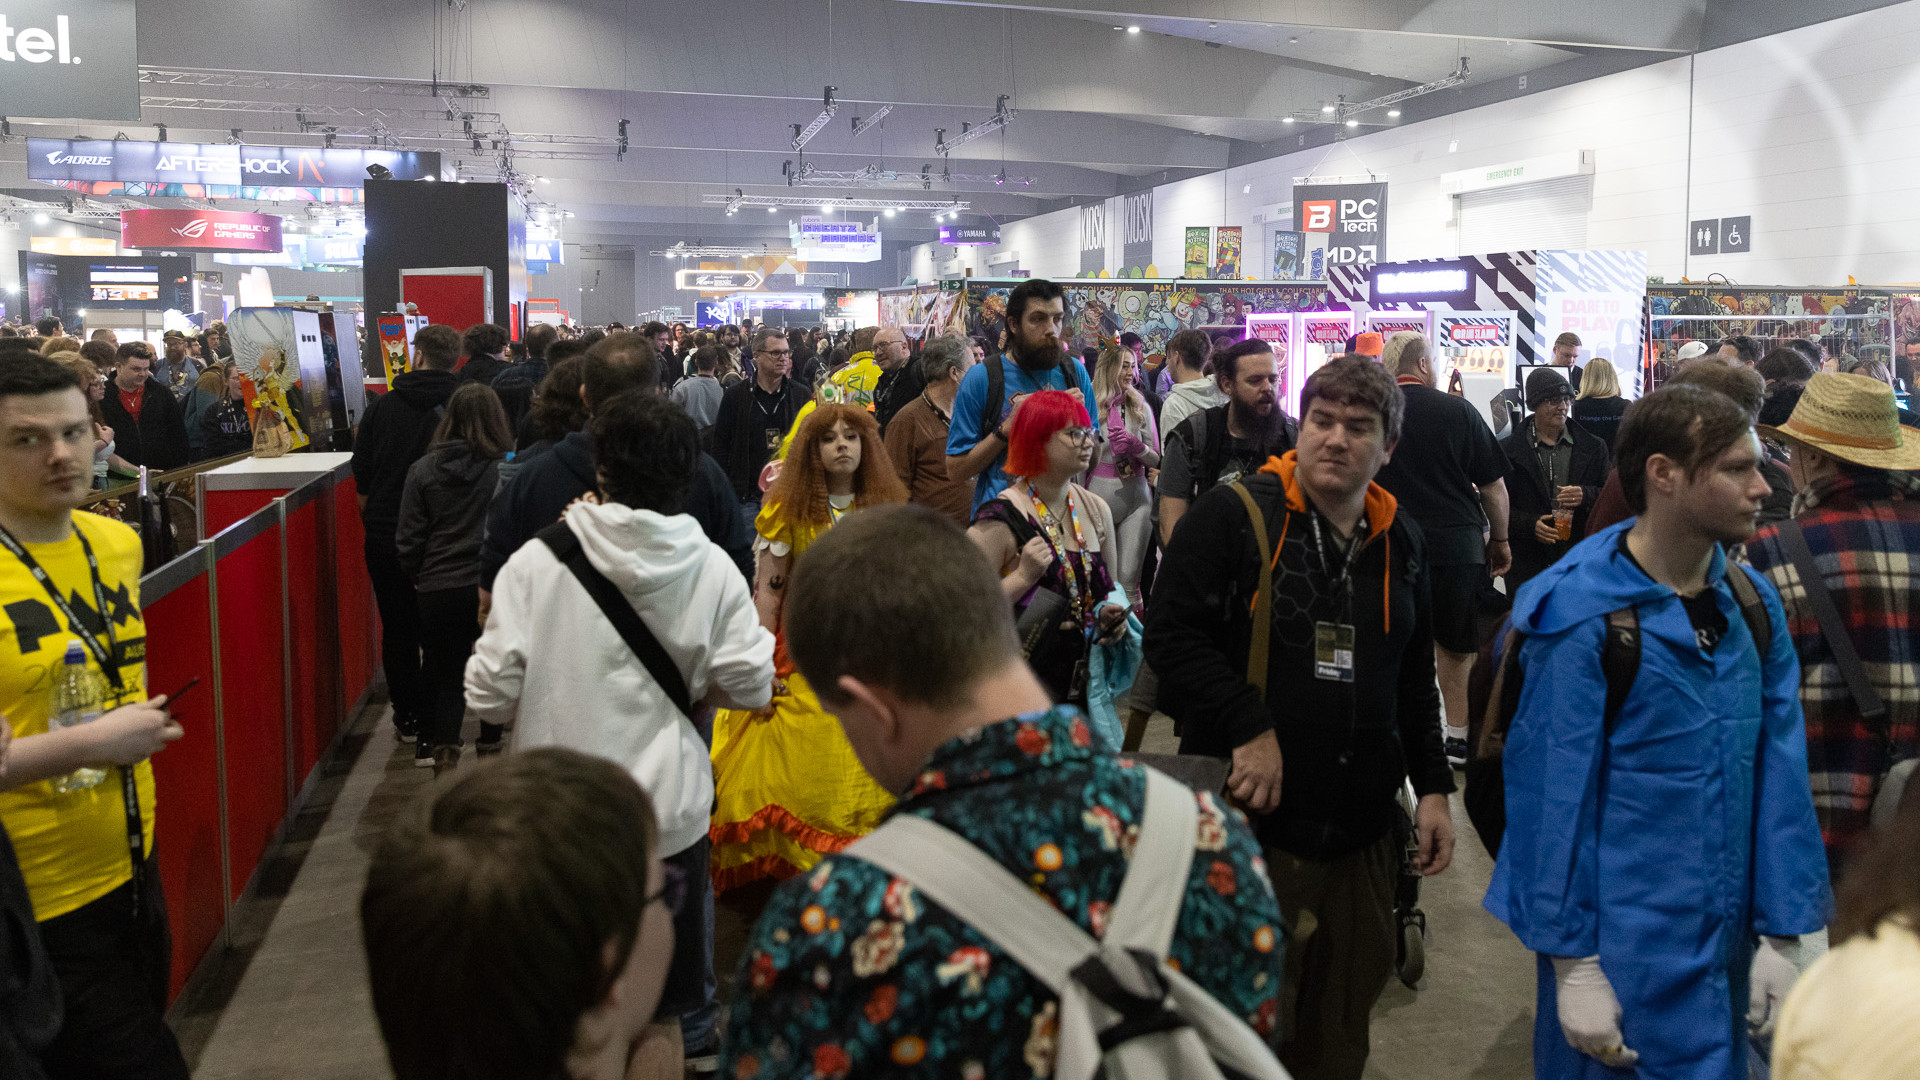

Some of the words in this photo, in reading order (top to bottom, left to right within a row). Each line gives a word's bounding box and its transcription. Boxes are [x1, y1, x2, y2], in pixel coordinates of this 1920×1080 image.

[1519, 75, 1527, 90] 9
[60, 155, 113, 166] AORUS
[155, 155, 291, 175] AFTERSHOCK
[1487, 168, 1513, 181] EMERGENCY
[1513, 166, 1524, 177] EXIT
[1340, 198, 1378, 219] PC
[1124, 193, 1152, 244] KIOSK
[1340, 218, 1378, 232] Tech
[214, 222, 262, 232] REPUBLIC
[262, 225, 271, 233] OF
[214, 230, 255, 240] GAMERS
[963, 229, 986, 238] YAMAHA
[1081, 203, 1105, 252] KIOSK
[1153, 284, 1172, 292] PAX
[1562, 299, 1601, 314] DARE
[1603, 299, 1620, 314] TO
[1562, 316, 1618, 331] PLAY
[1317, 665, 1342, 678] Friday
